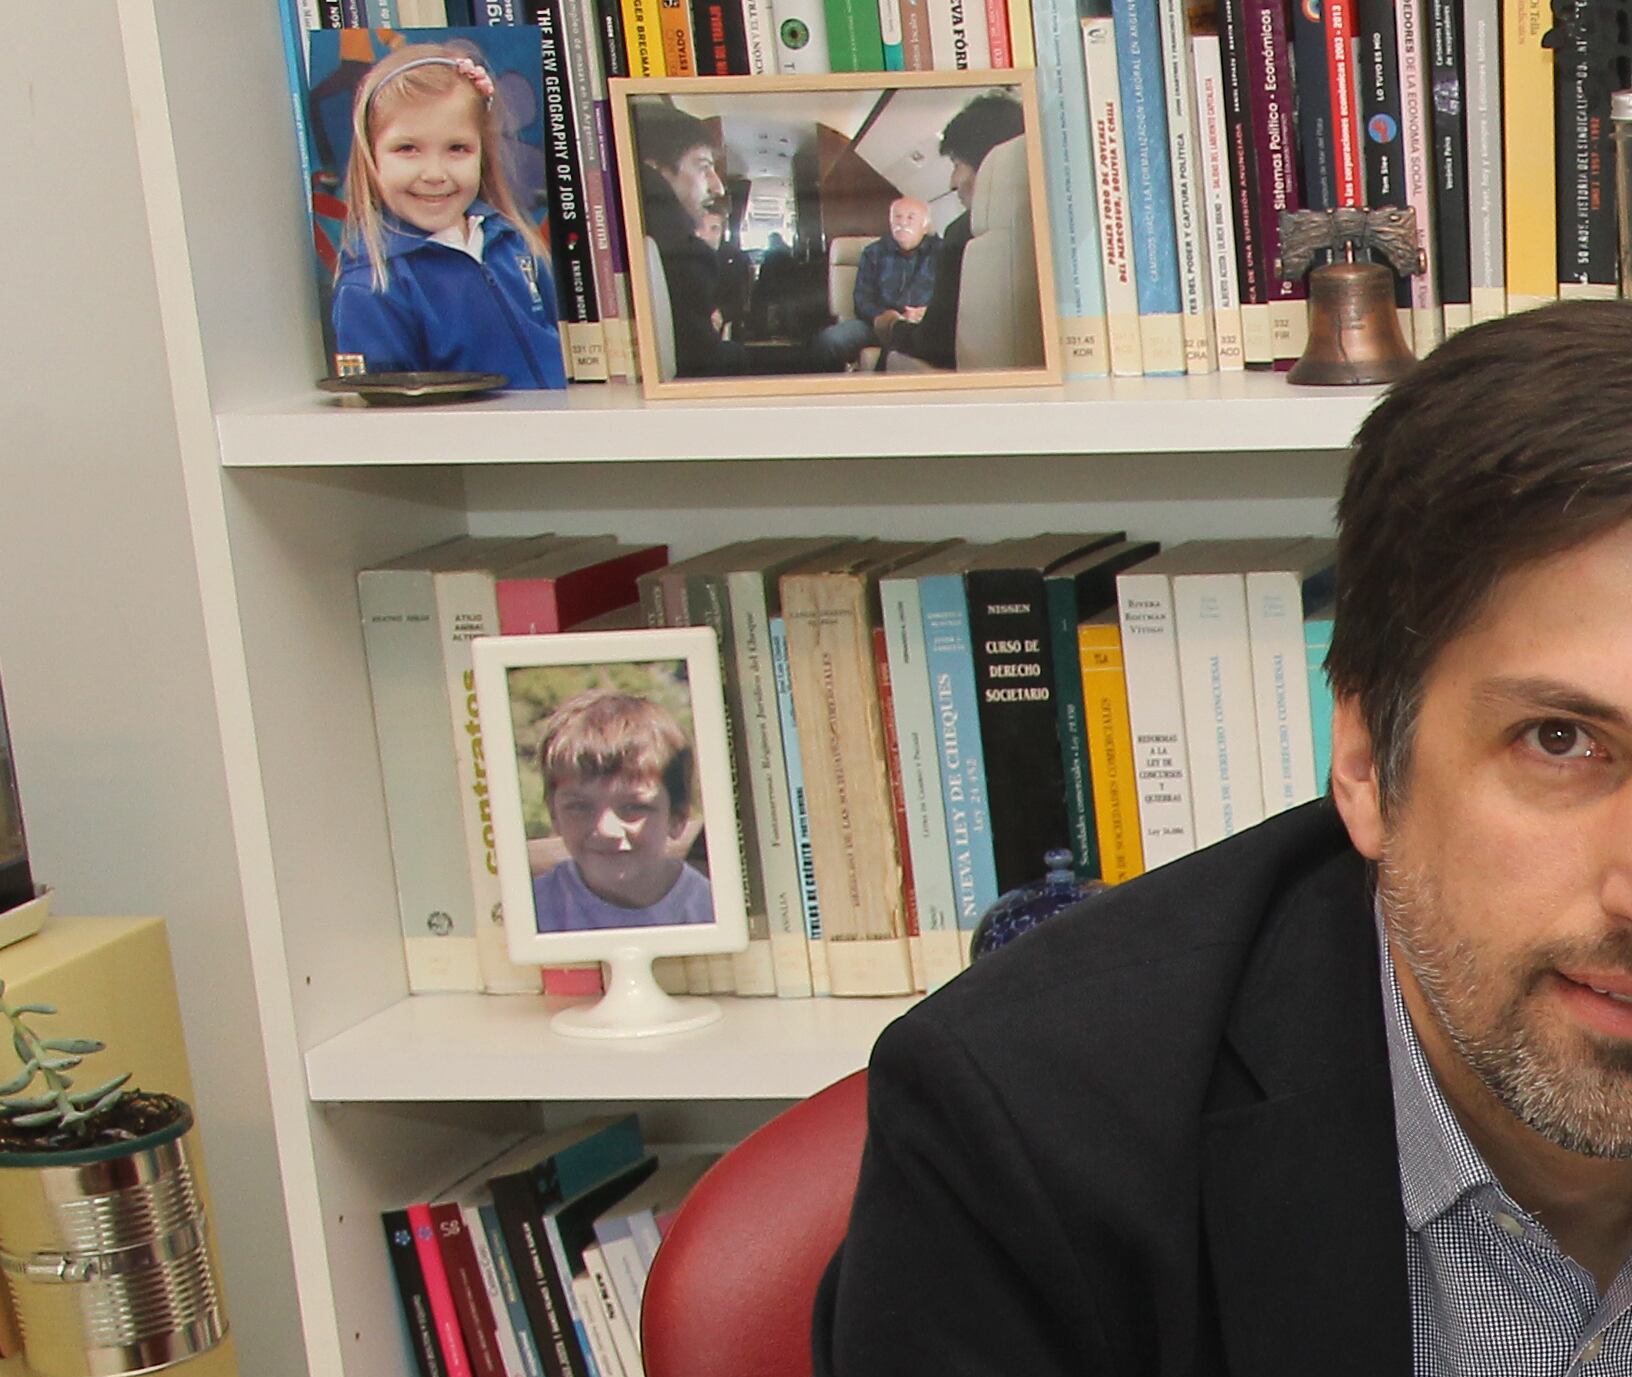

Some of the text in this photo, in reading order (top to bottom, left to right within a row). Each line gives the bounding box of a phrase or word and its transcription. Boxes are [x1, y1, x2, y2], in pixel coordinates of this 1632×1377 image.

[1330, 4, 1343, 28] 2013
[674, 28, 689, 71] ESTADO
[1332, 36, 1345, 60] 2003
[1373, 50, 1383, 62] ES
[1373, 62, 1385, 88] TUYO
[1402, 55, 1416, 72] DE
[1334, 61, 1349, 115] económicas
[1375, 88, 1385, 101] LO
[1403, 74, 1417, 90] LA
[535, 7, 579, 221] THE NEW GEOGRAPHY OF JOBS
[1104, 100, 1116, 132] CHILE
[1259, 7, 1286, 210] Sistemas Político Económicos
[1175, 132, 1187, 178] POLÍTICA
[1338, 117, 1354, 181] corporaciones
[1100, 170, 1110, 185] DE
[1108, 148, 1121, 192] BOLIVIA
[1381, 174, 1390, 194] Tom
[1409, 156, 1425, 197] SOCIAL
[1101, 188, 1113, 219] FORO
[1179, 181, 1191, 228] CAPTURA
[1104, 223, 1116, 265] PRIMER
[1183, 240, 1195, 273] PODER
[1118, 263, 1129, 283] DEL
[1186, 275, 1197, 294] DEL
[987, 603, 1031, 615] NISSEN
[986, 639, 1041, 654] CURSO DE
[989, 664, 1041, 678] DERECHO
[986, 687, 1050, 703] SOCIETARIO
[456, 668, 500, 877] contratos
[933, 671, 980, 917] NUEVA LEY DE CHEQUES
